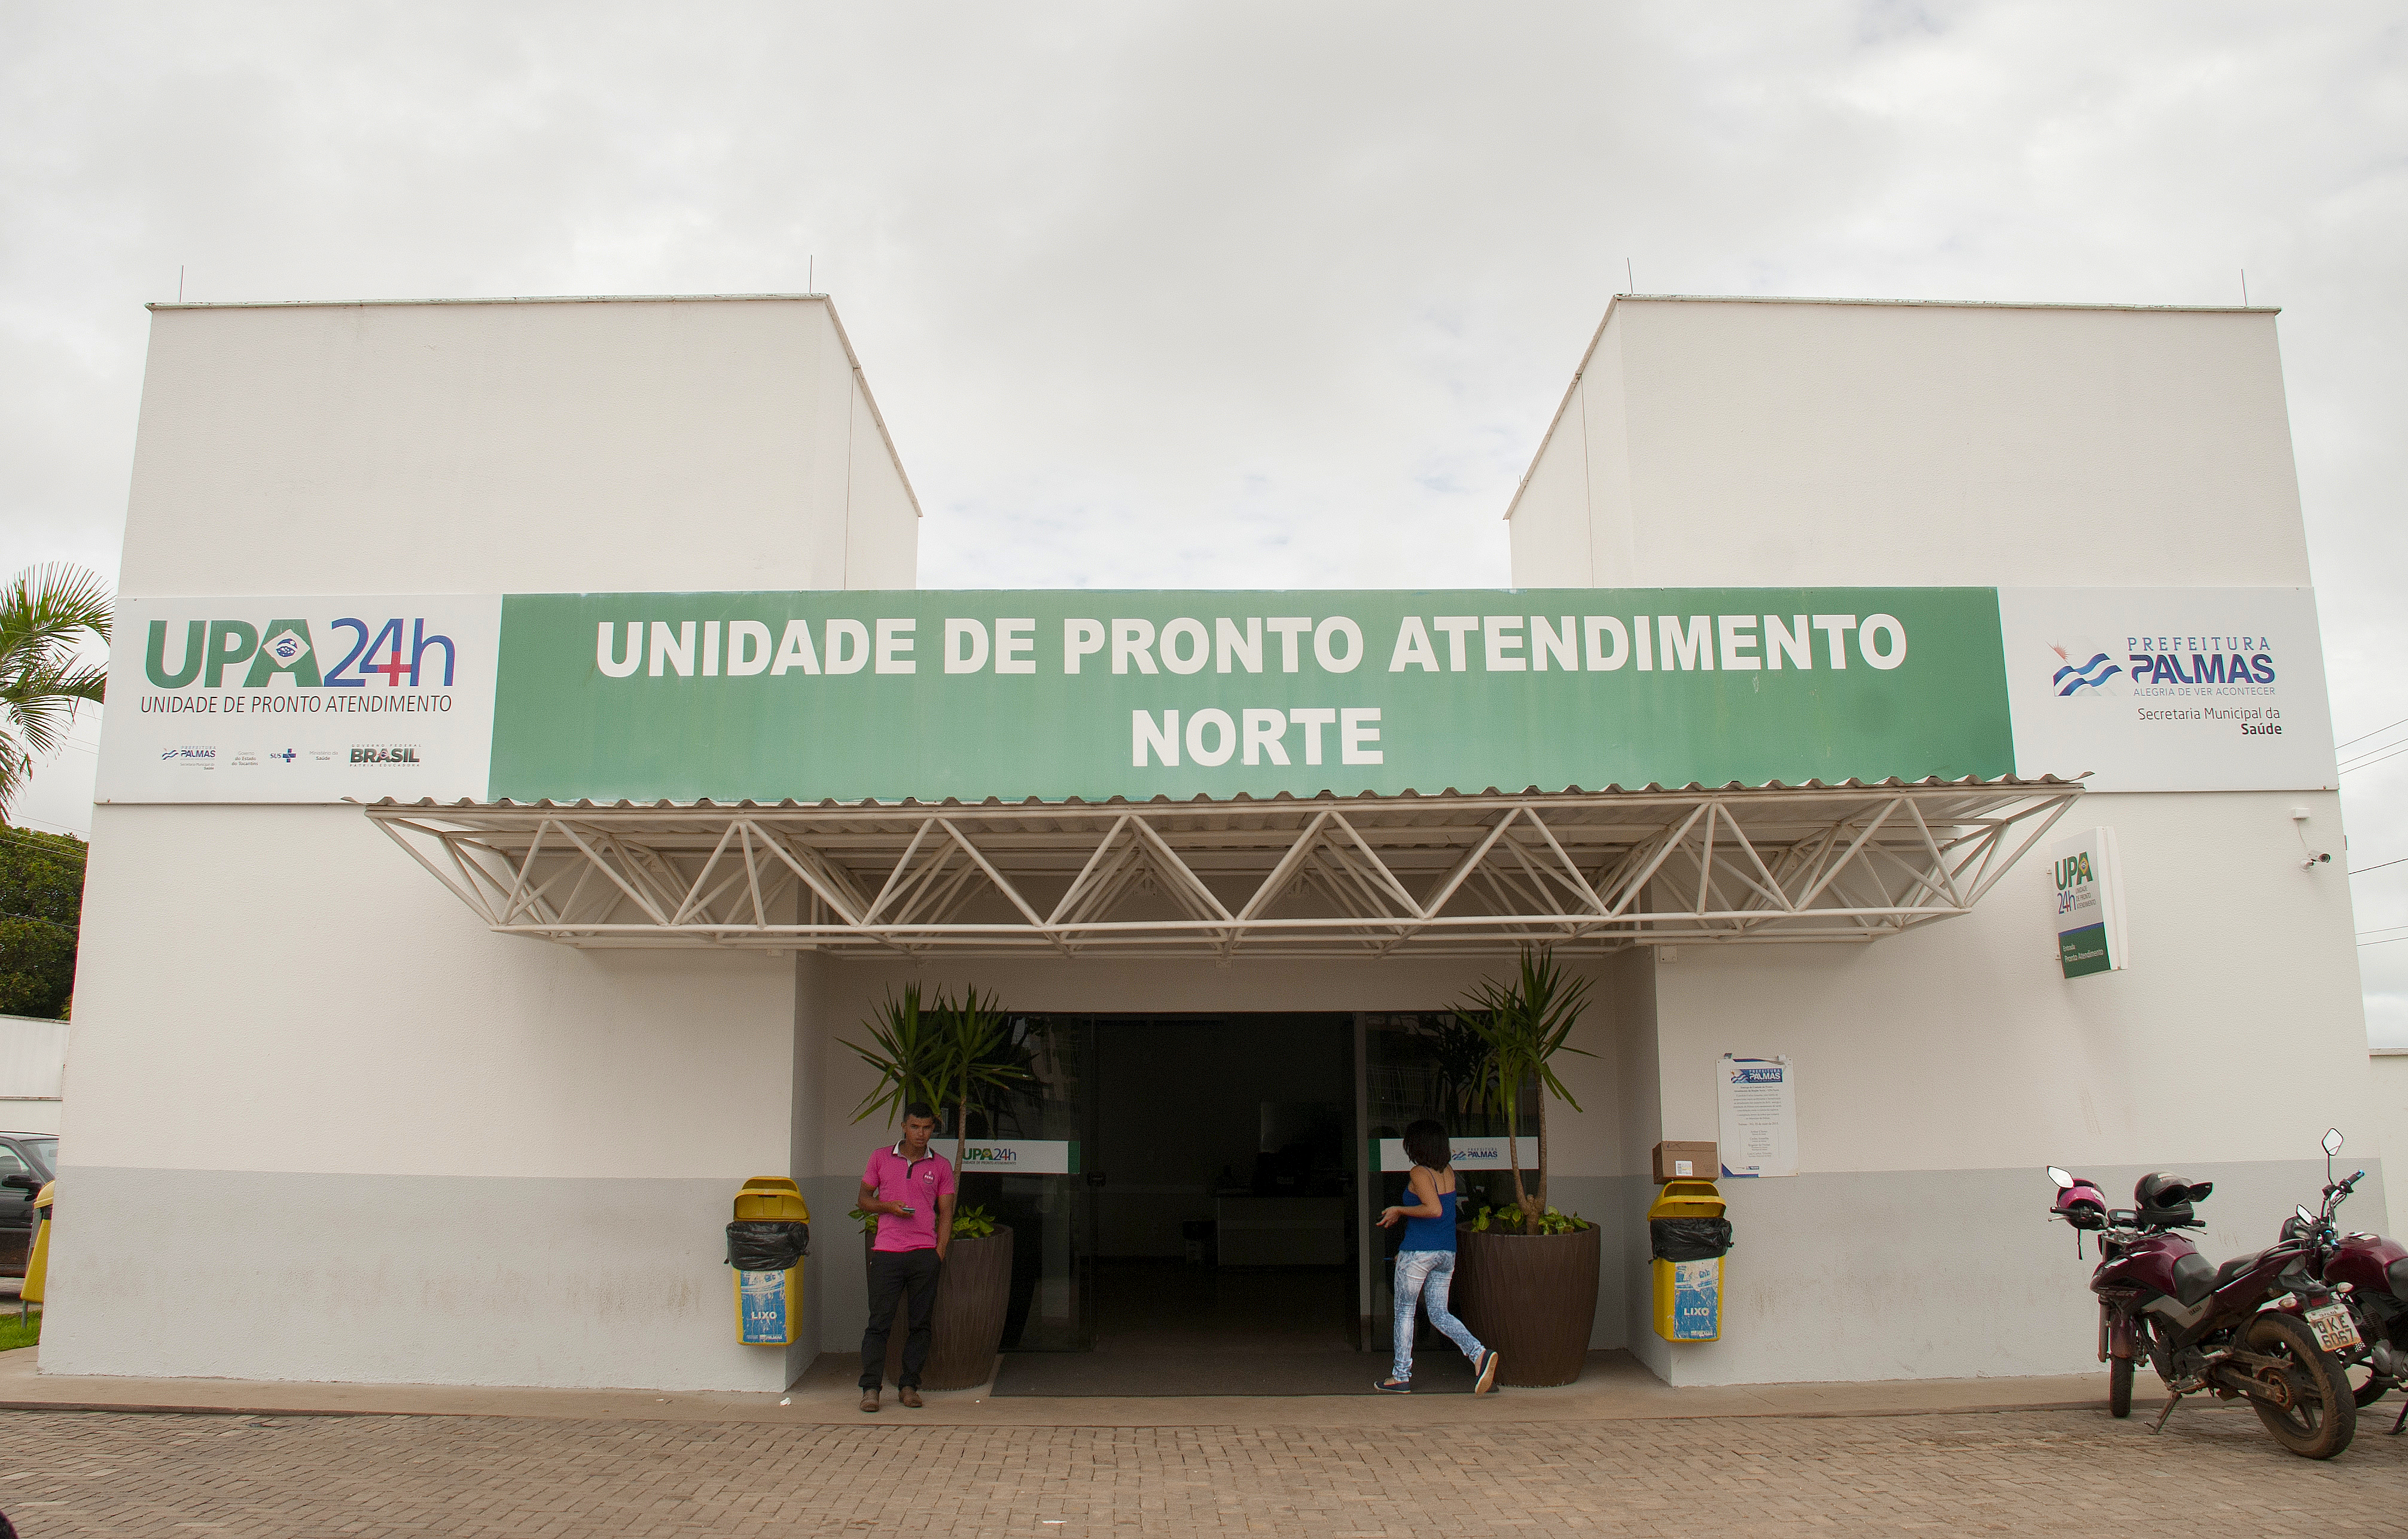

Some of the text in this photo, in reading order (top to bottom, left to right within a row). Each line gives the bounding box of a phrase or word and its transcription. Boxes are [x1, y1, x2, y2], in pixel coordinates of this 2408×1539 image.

[596, 613, 1906, 677] UNIDADE DE PRONTO ATENDIMENTO
[2127, 636, 2271, 651] PREFEITURA
[2129, 654, 2276, 685] PALMAS
[2133, 687, 2276, 696] ALEGRIA DE VER ACONTECER
[141, 695, 452, 713] UNIDADE DE PRONTO ATENDIMENTO
[2138, 706, 2281, 721] Secretaria Municipal da
[2241, 722, 2282, 735] Saúde
[1132, 708, 1384, 767] NORTE
[350, 748, 420, 763] BRASIL
[2055, 851, 2093, 891] UPA
[2057, 890, 2077, 914] 24h
[751, 1311, 777, 1320] LIXO
[1684, 1308, 1709, 1316] LIXO
